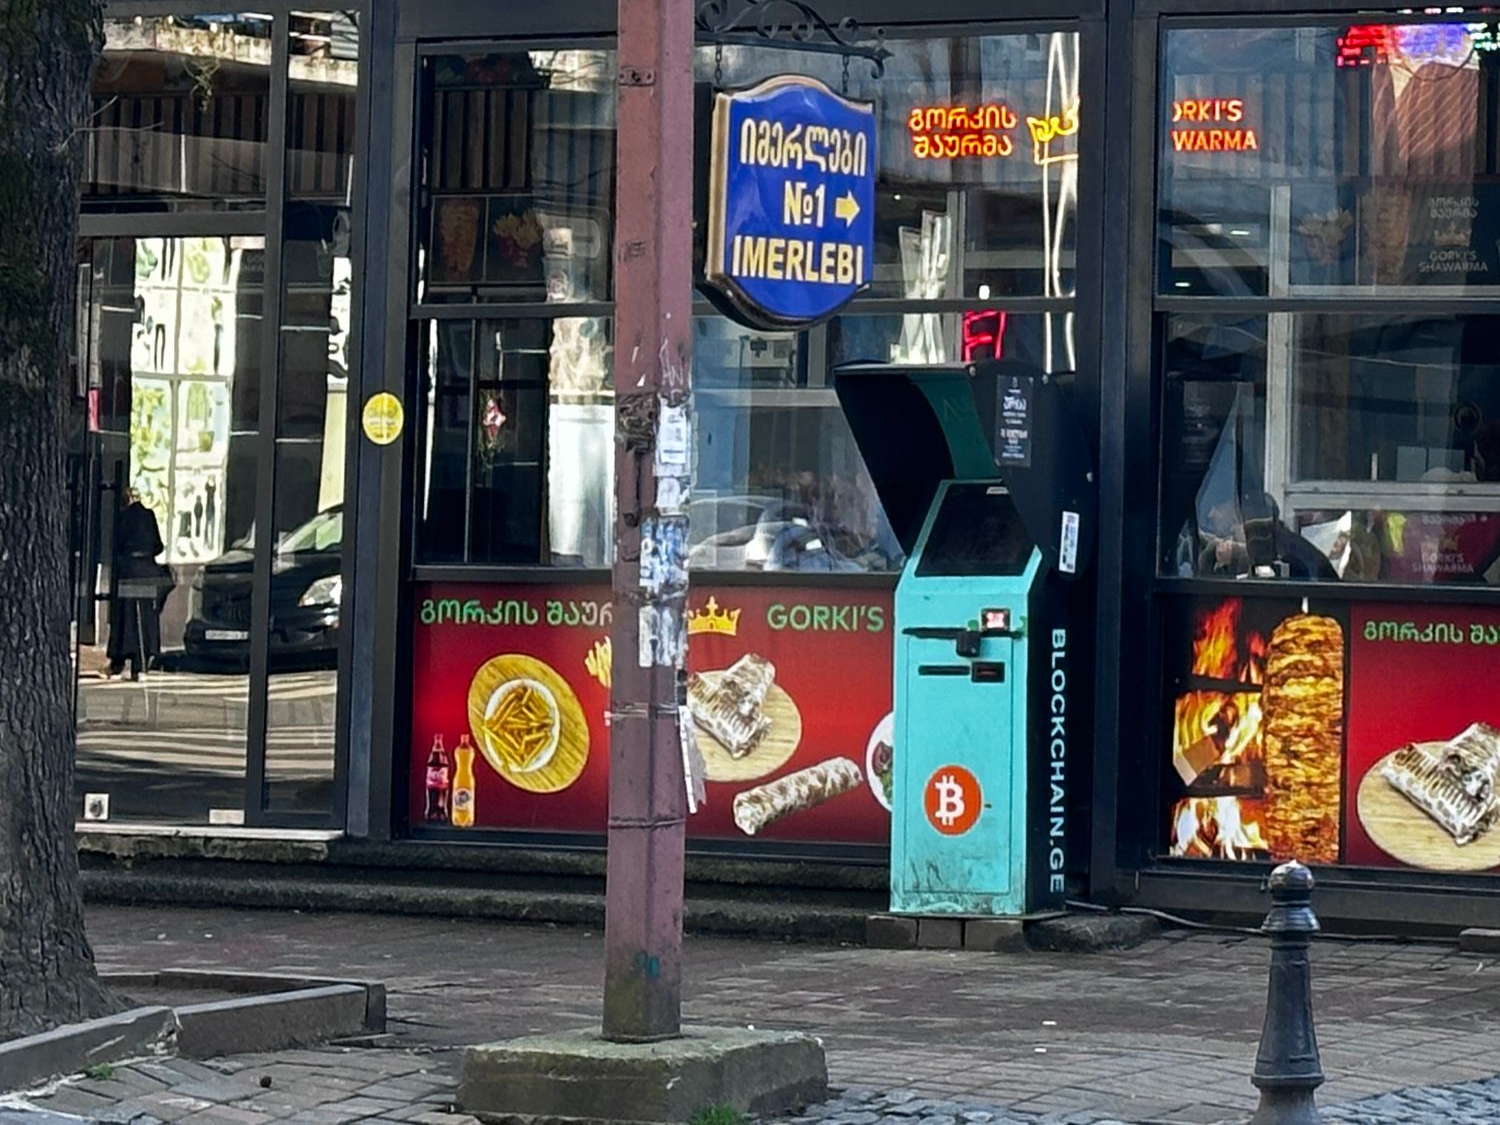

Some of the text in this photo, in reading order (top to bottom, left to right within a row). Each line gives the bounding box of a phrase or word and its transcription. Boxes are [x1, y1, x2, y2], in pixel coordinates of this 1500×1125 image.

[908, 105, 1018, 132] გორკის
[739, 117, 868, 178] იმერლები
[911, 133, 1014, 159] შაურმა
[1171, 129, 1259, 152] WARMA
[731, 234, 864, 286] IMERLEBI
[420, 599, 539, 625] გორკის
[766, 603, 885, 633] GORKI'S
[1364, 620, 1464, 644] გორკის
[1048, 627, 1067, 895] BLOCKCHAIN.GE
